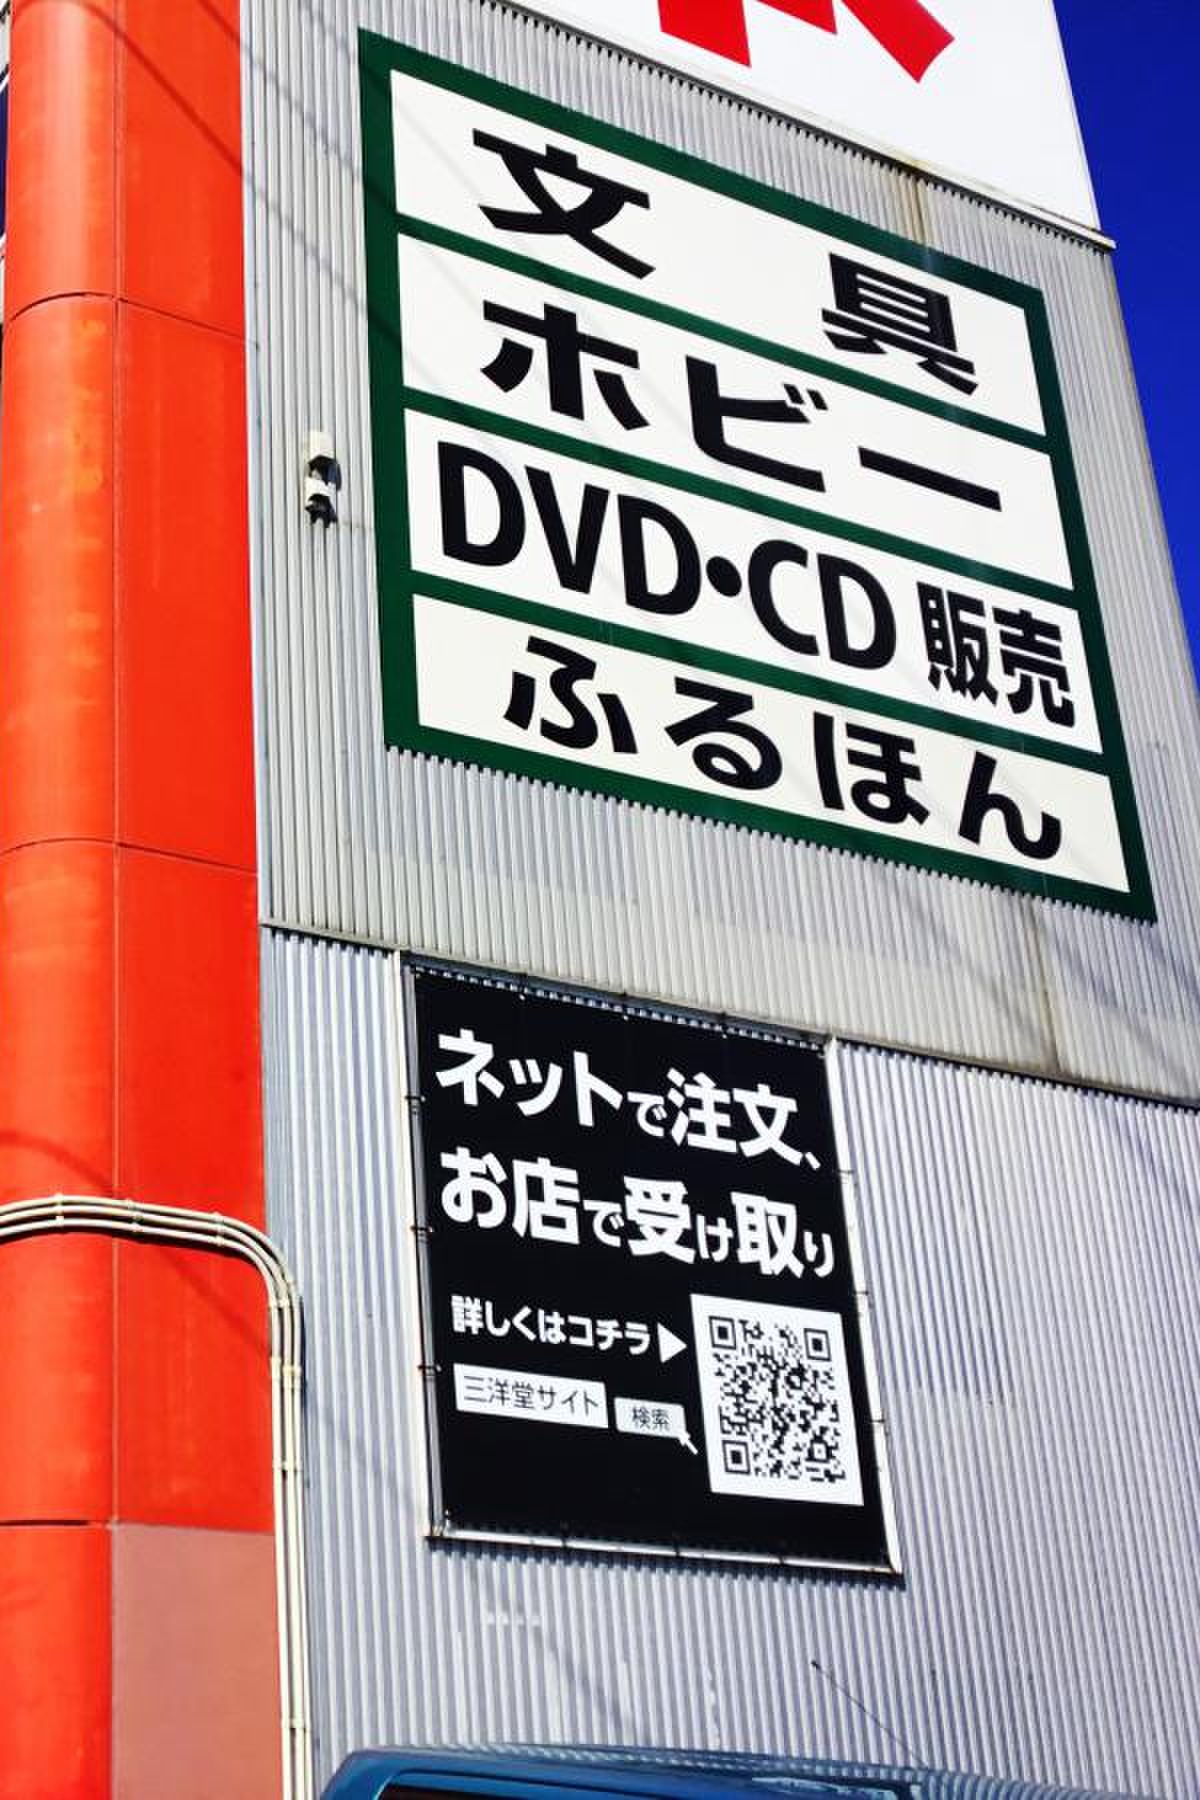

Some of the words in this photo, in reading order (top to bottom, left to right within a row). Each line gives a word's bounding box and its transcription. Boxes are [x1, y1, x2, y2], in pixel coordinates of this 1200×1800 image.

[472, 127, 979, 395] 文具
[480, 299, 1003, 512] ホビー
[917, 581, 1076, 729] 販売
[503, 635, 1062, 862] ふるほん
[435, 1028, 821, 1170] ネットで注文、
[439, 1146, 836, 1279] お店で受け取り
[451, 1293, 651, 1355] 詳しくはコチラ
[463, 1374, 599, 1417] 三洋堂サイト
[631, 1406, 672, 1432] 検索
